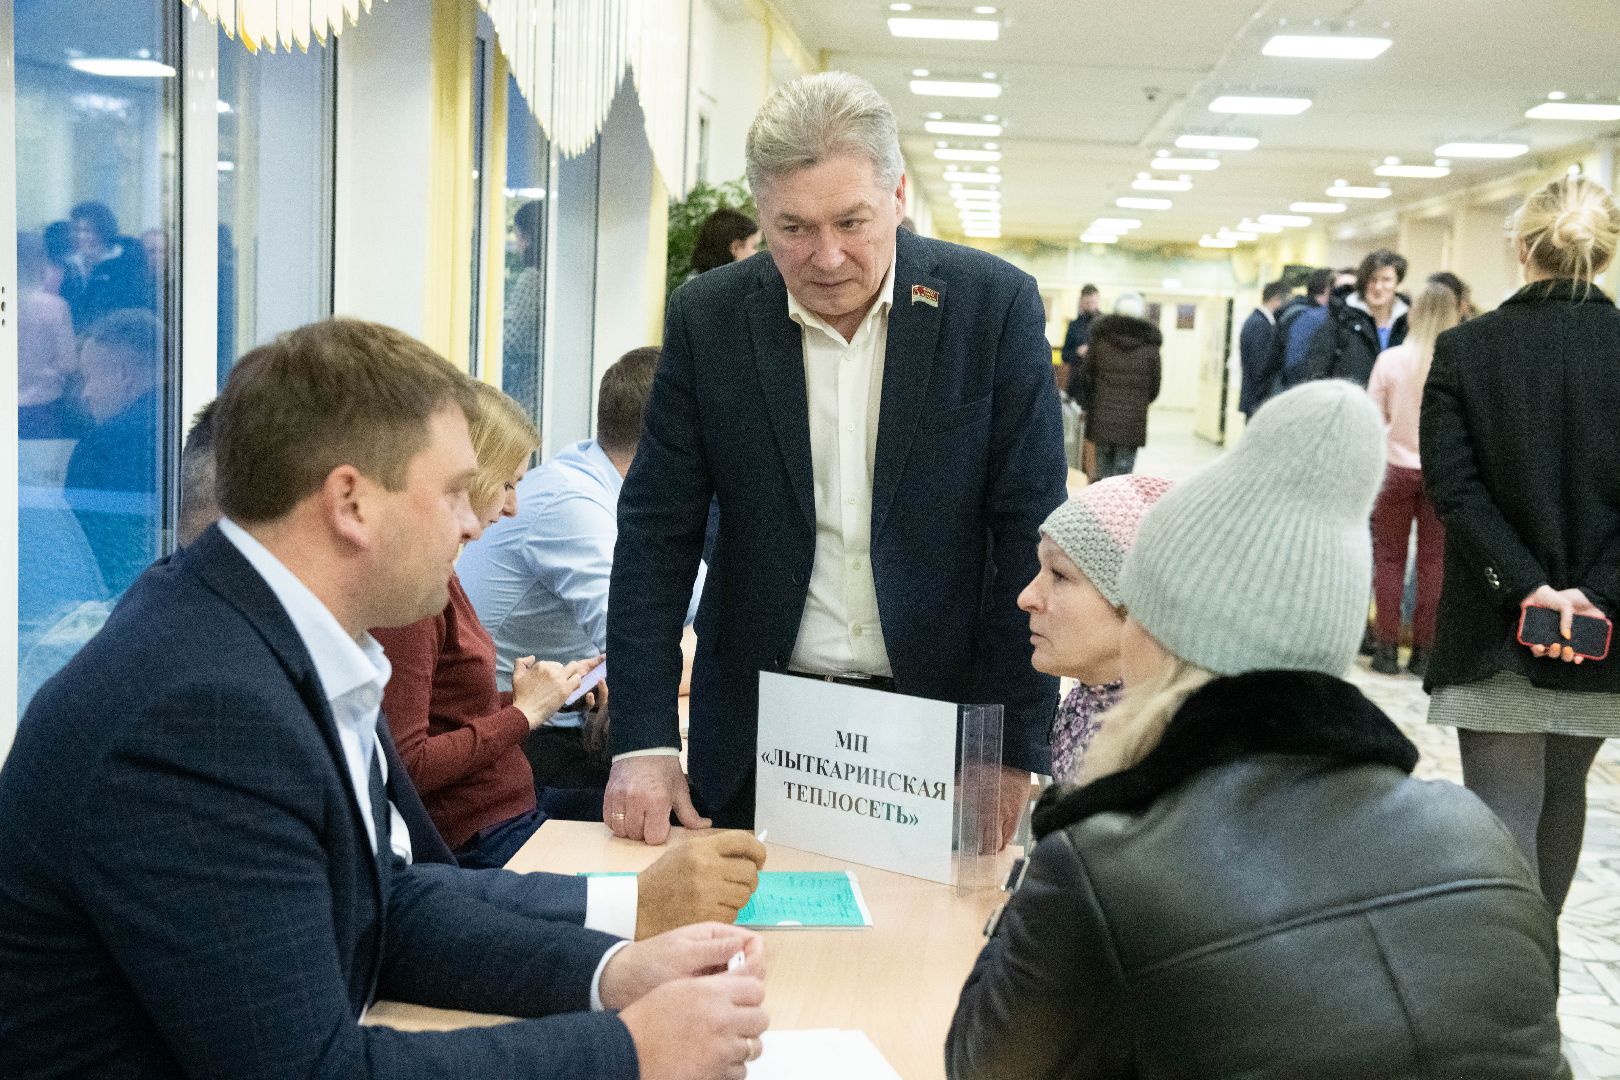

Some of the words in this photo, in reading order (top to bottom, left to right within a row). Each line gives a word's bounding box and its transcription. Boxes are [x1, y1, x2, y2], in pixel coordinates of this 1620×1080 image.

[835, 730, 868, 753] МП
[761, 748, 947, 801] «ЛЫТКАРИНСКАЯ
[783, 781, 919, 826] ТЕПЛОСЕТЬ»
